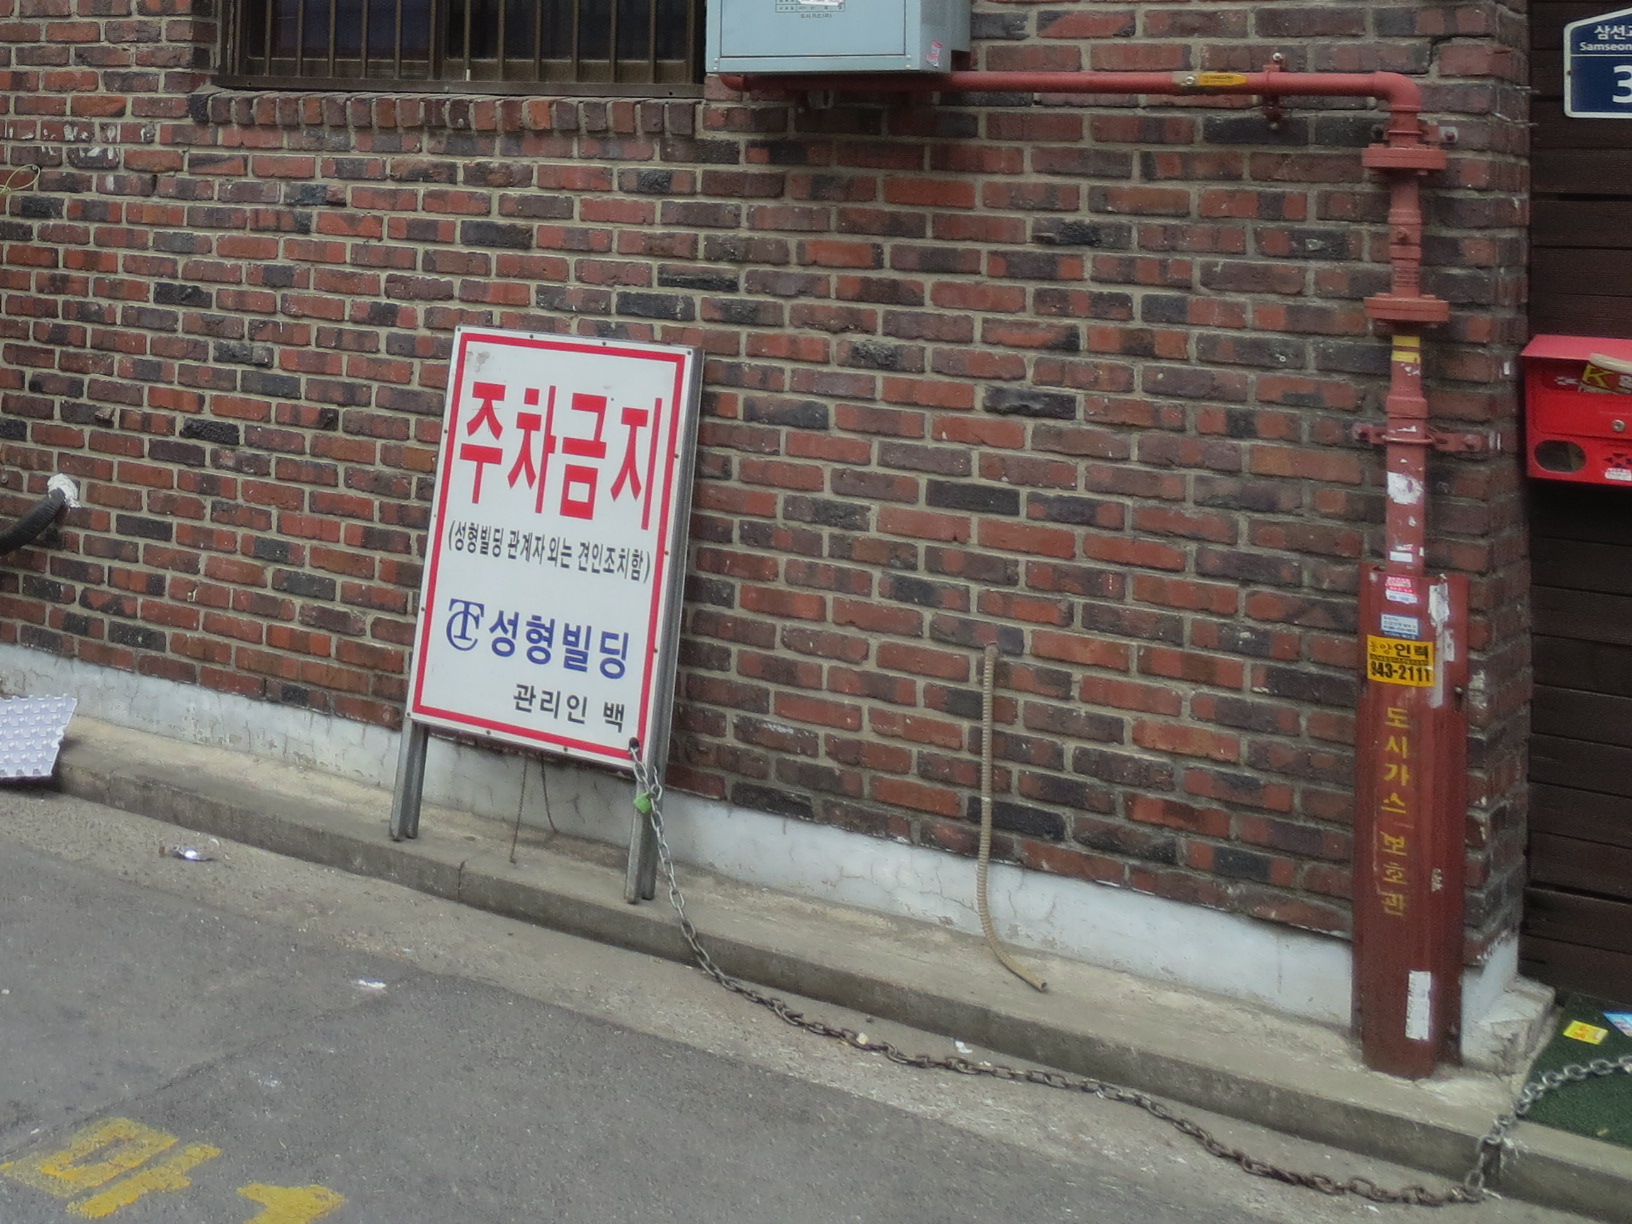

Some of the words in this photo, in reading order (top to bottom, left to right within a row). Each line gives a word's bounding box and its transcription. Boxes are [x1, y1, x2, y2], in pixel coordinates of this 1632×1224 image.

[459, 380, 664, 531] 주차금지
[577, 541, 651, 584] 견인조치함)
[488, 608, 630, 680] 성형빌딩
[512, 683, 588, 725] 관리인
[602, 700, 626, 733] 백
[1380, 706, 1411, 815] 도시가스
